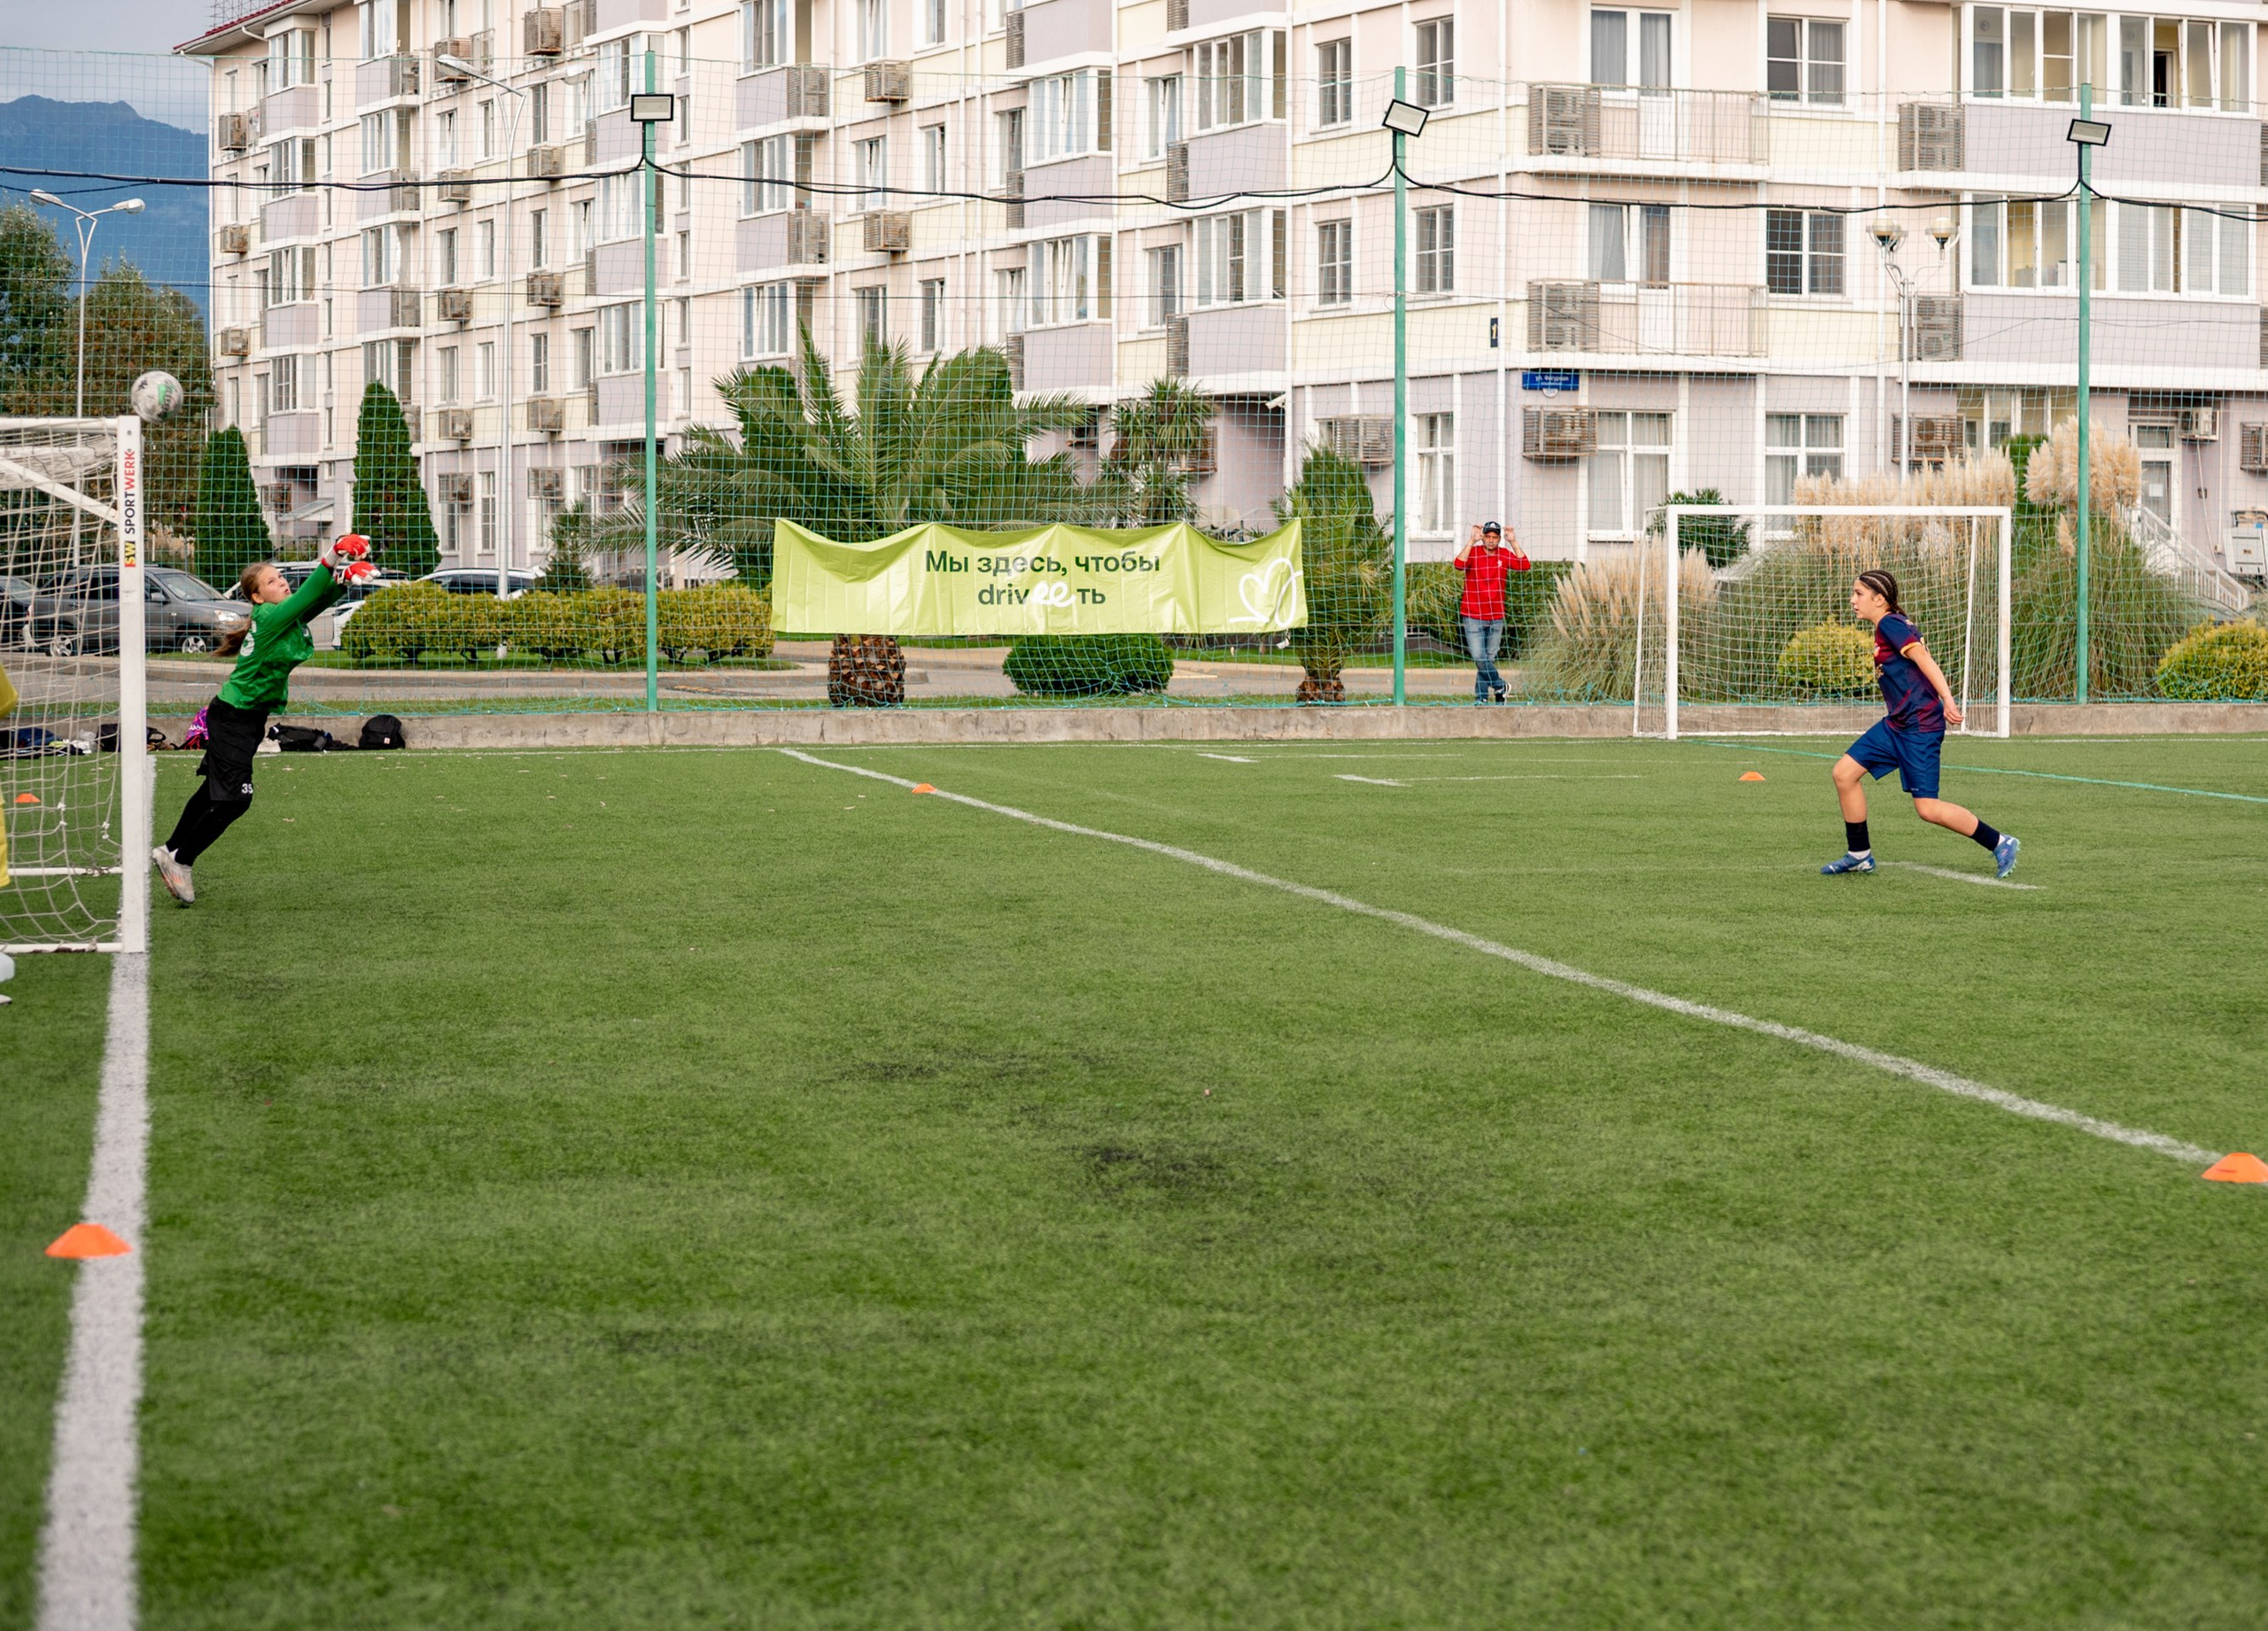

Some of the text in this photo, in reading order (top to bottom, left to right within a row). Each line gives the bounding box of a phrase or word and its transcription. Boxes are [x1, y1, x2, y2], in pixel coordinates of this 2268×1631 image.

[124, 451, 136, 567] SW SPORTWERK
[926, 550, 1161, 577] Мы здесь, чтобы
[241, 783, 254, 794] 35
